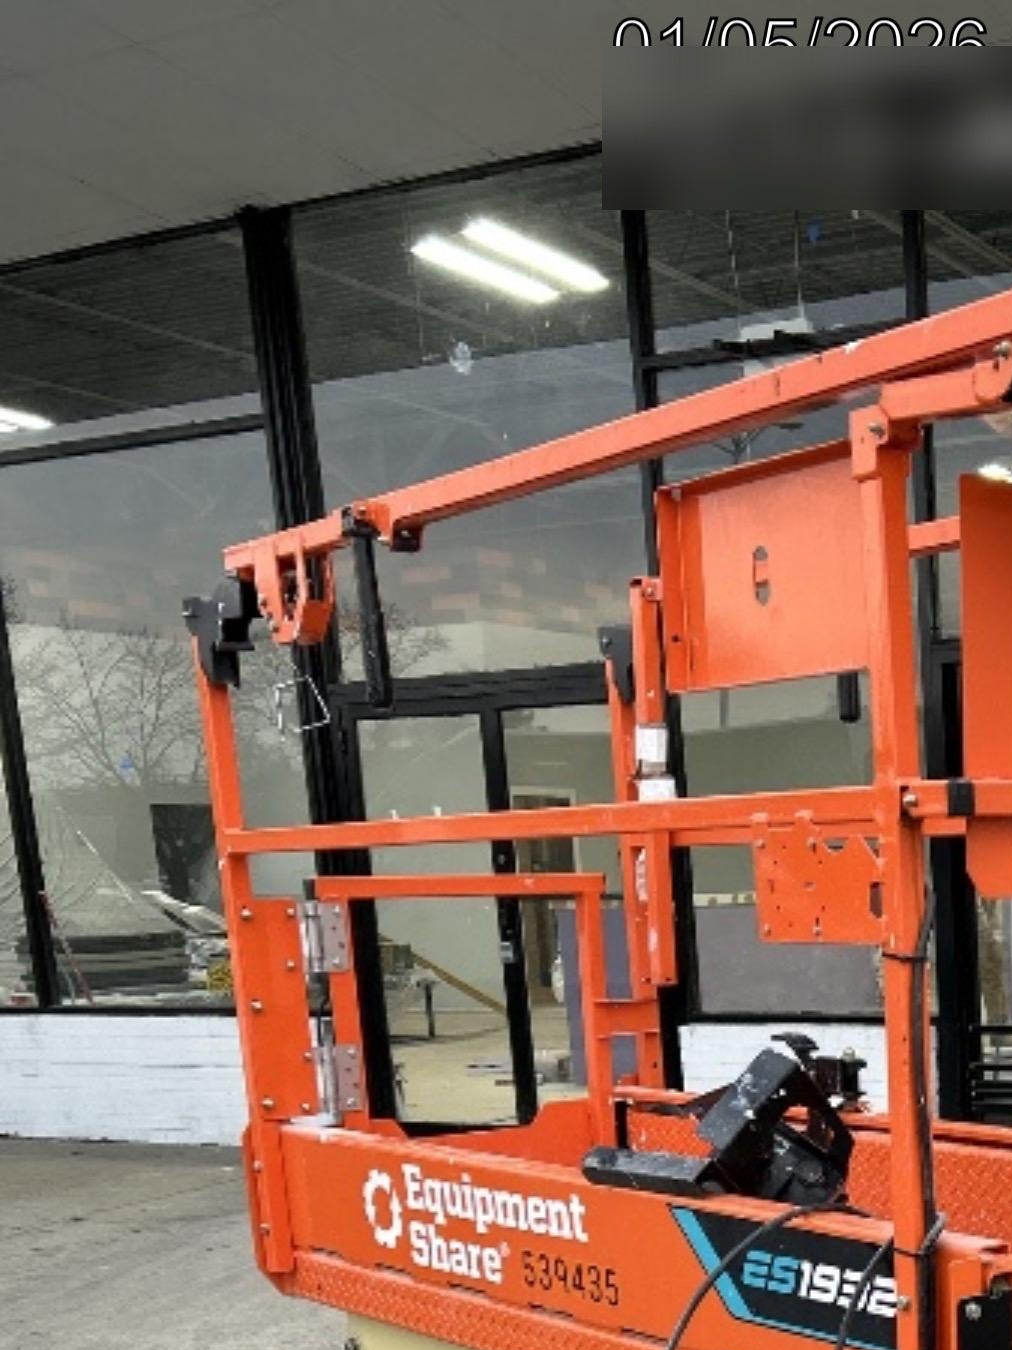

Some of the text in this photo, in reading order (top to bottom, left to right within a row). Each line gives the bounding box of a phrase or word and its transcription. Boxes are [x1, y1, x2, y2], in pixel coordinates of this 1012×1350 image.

[401, 1163, 589, 1242] Equipment
[409, 1221, 504, 1284] Share
[521, 1250, 619, 1306] 539435
[742, 1250, 899, 1318] ES1932
